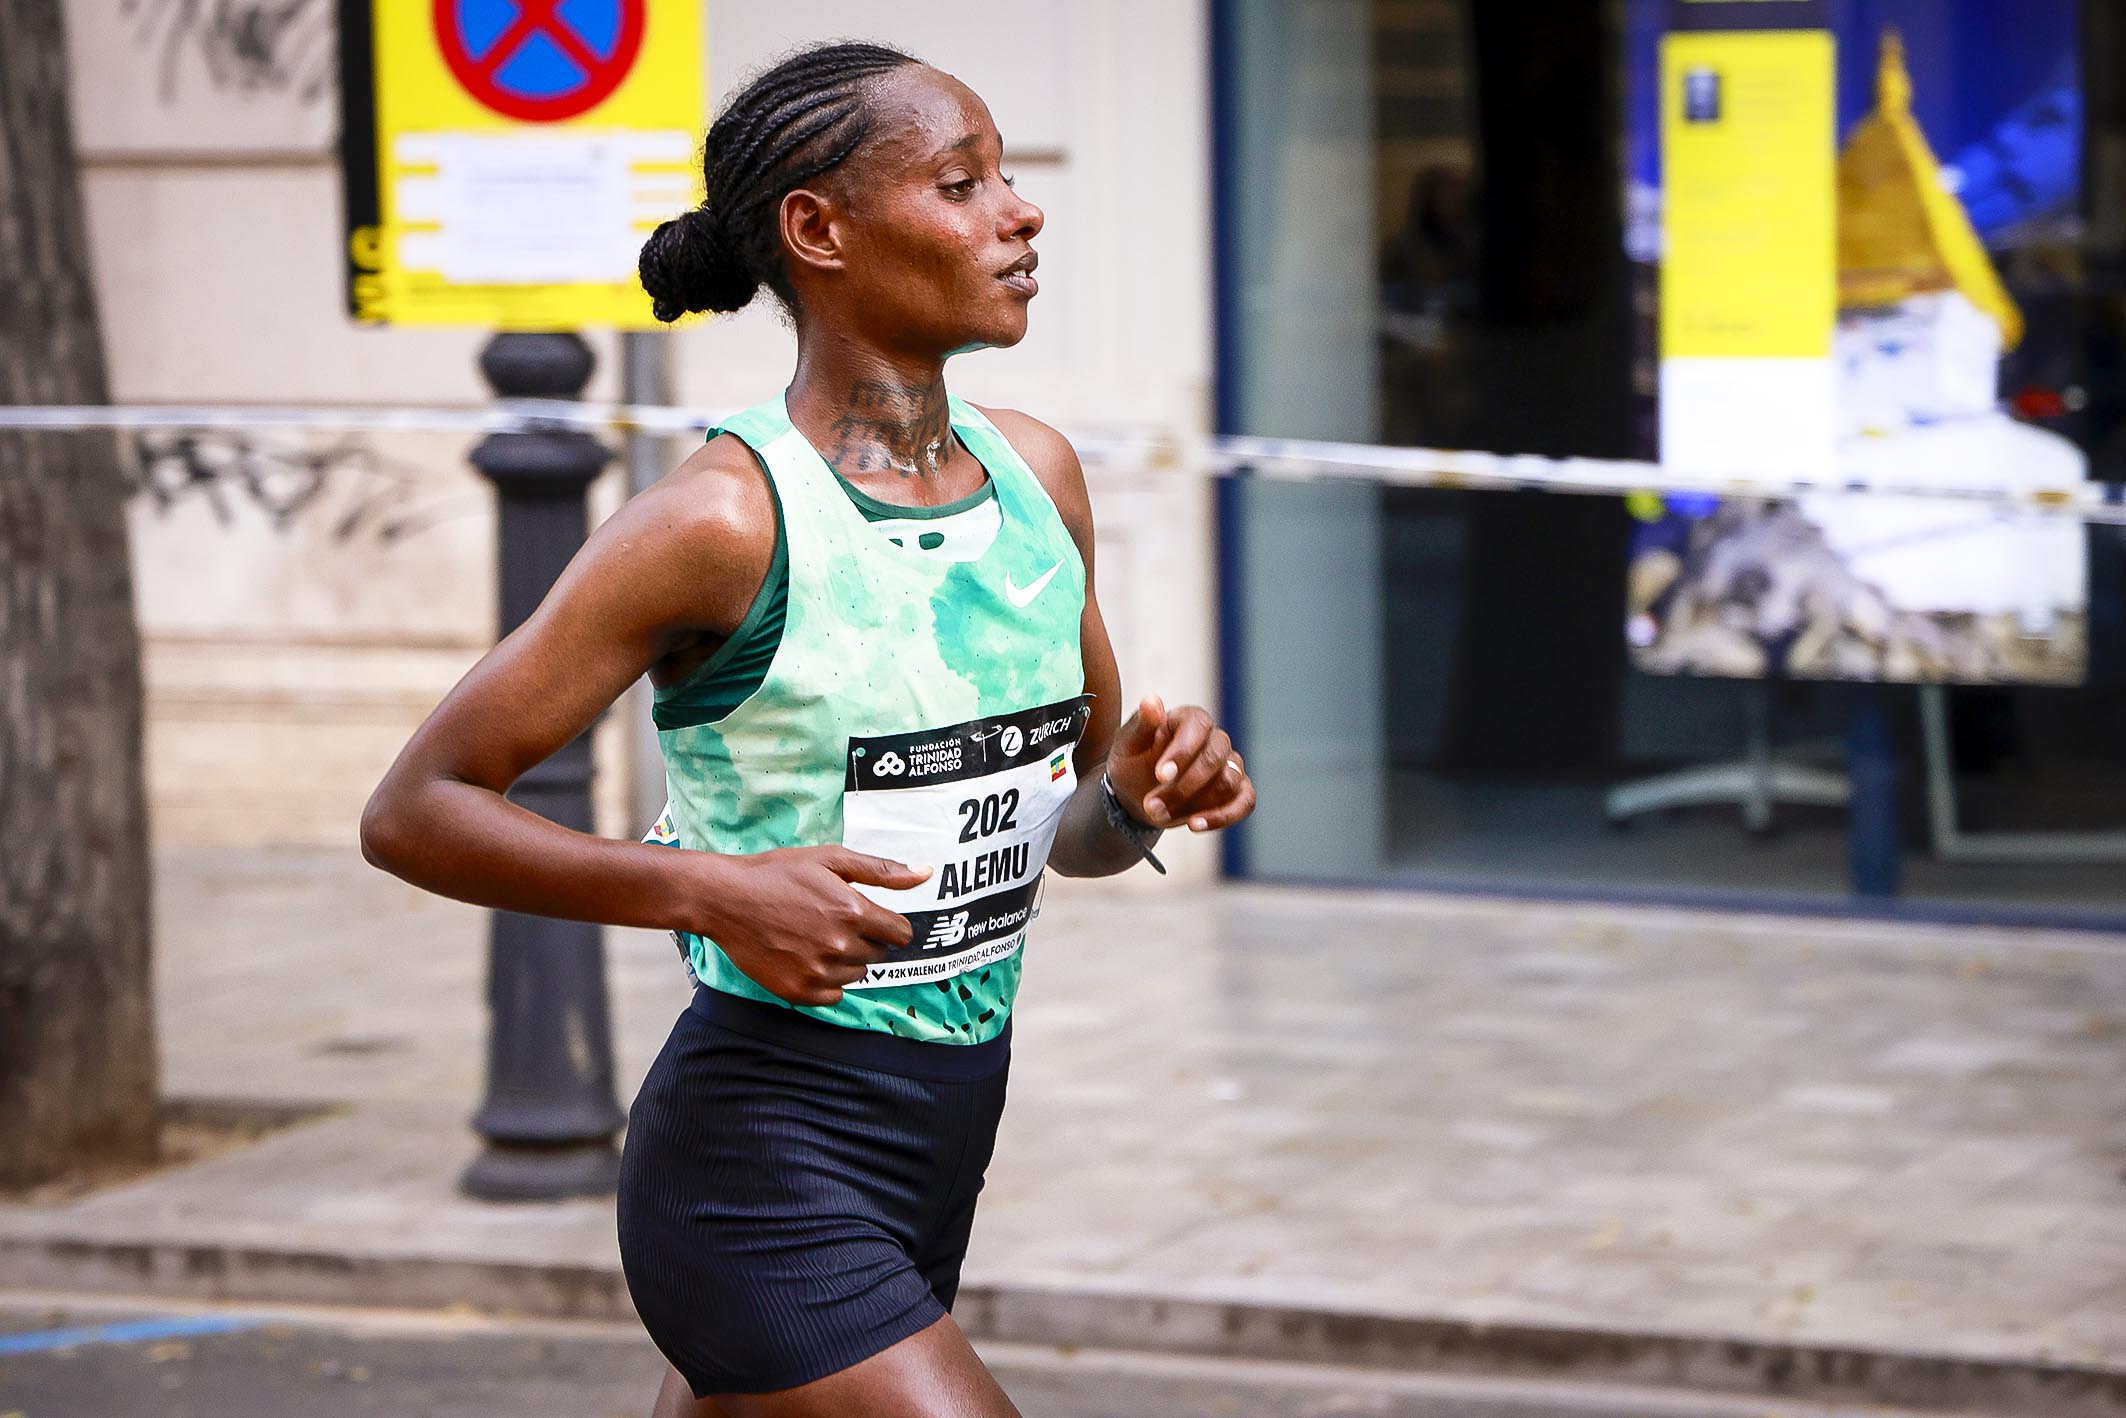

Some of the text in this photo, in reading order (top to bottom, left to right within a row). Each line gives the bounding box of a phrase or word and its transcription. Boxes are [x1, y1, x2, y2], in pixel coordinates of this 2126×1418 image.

[909, 738, 962, 753] FUNDACIÓN
[1029, 716, 1072, 746] ZURICH
[908, 747, 962, 766] TRINIDAD
[908, 759, 963, 778] ALFONSO
[958, 787, 1020, 844] 202
[937, 842, 1030, 900] ALEMU
[967, 920, 988, 939] new
[988, 906, 1028, 931] balance
[887, 968, 907, 979] 42K
[907, 963, 946, 977] VALENCIA
[981, 939, 1016, 959] ALFONSO
